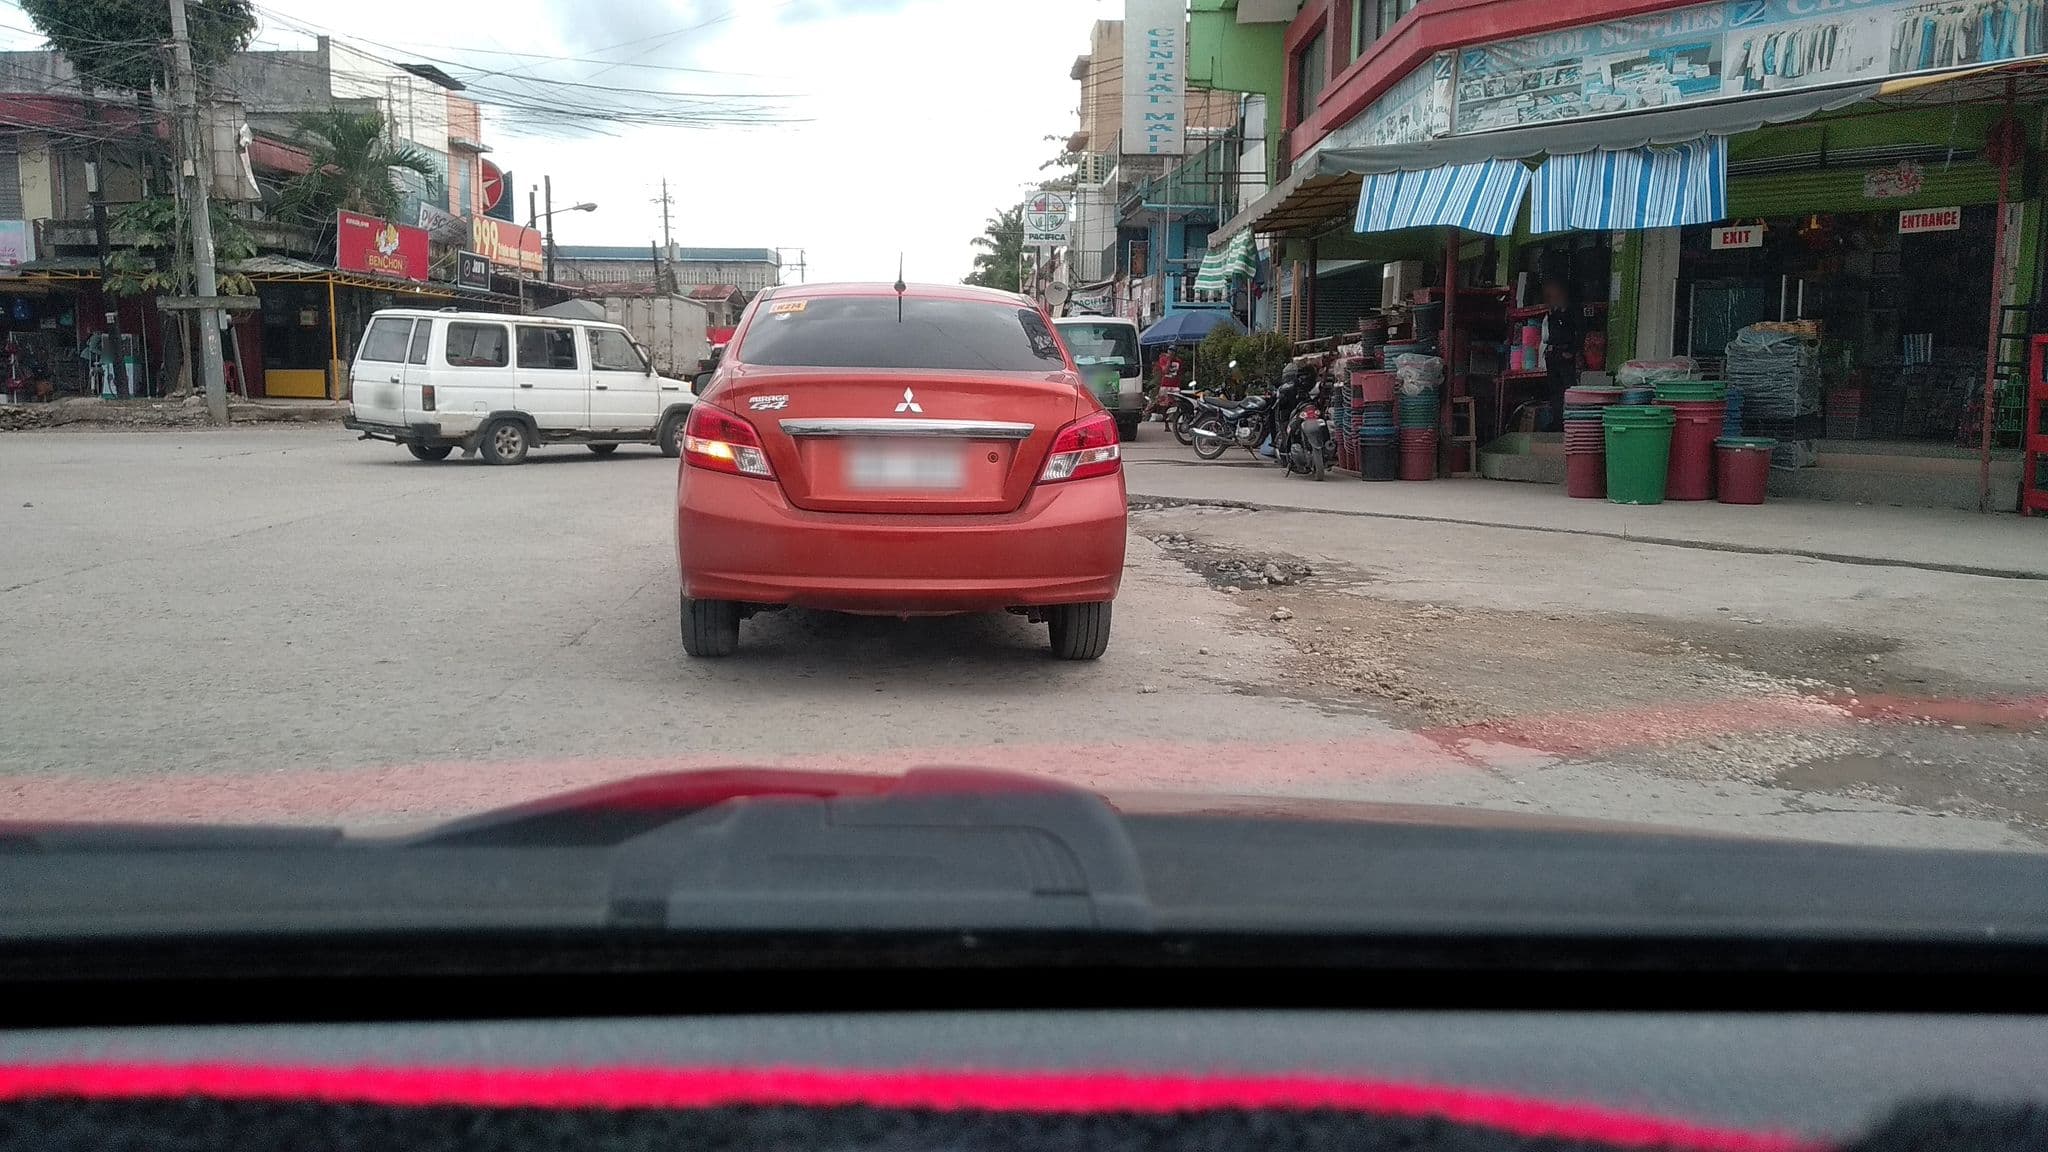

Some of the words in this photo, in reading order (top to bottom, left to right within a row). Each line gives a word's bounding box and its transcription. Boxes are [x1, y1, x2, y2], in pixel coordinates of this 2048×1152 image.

[1901, 211, 1958, 229] ENTRANCE
[473, 217, 499, 260] 999
[1028, 232, 1066, 241] PACIFICA
[1722, 230, 1752, 245] EXIT
[749, 394, 789, 403] MIRAGE
[750, 401, 788, 410] G4
